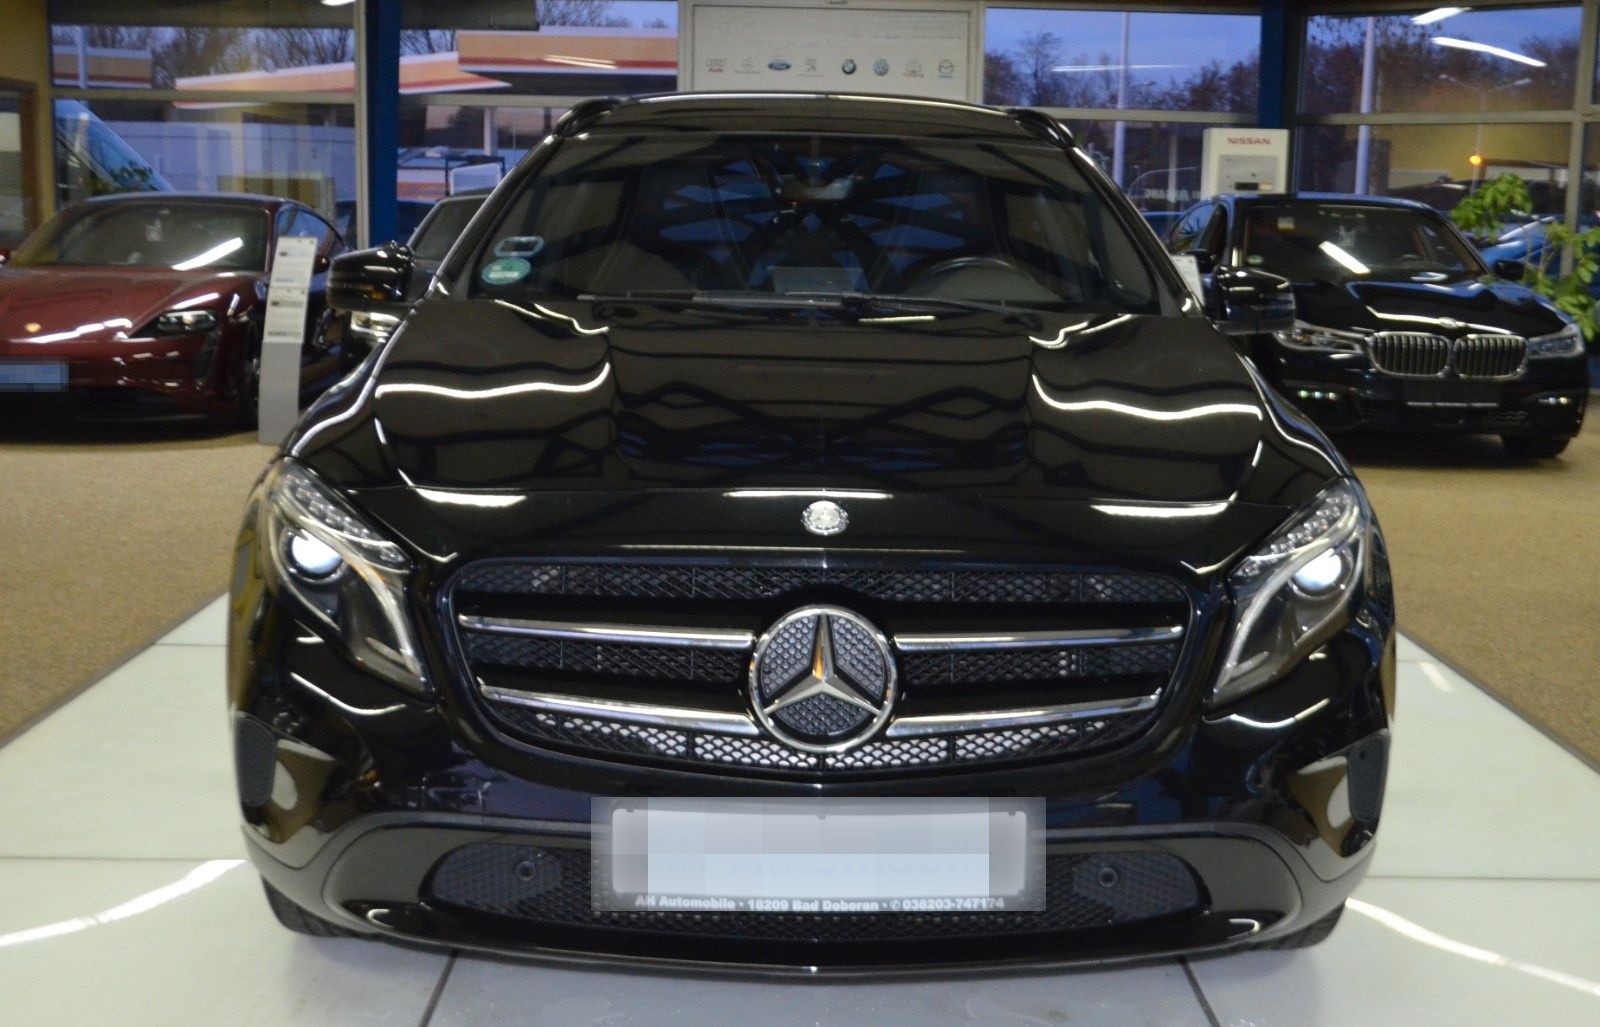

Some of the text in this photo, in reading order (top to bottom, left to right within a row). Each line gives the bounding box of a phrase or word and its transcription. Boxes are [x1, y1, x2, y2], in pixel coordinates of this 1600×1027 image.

[1227, 137, 1271, 145] NISSAN
[635, 895, 656, 907] AH
[659, 895, 736, 909] Automobile
[748, 898, 789, 911] 18209
[792, 899, 819, 911] Bad
[822, 899, 879, 911] Doberan
